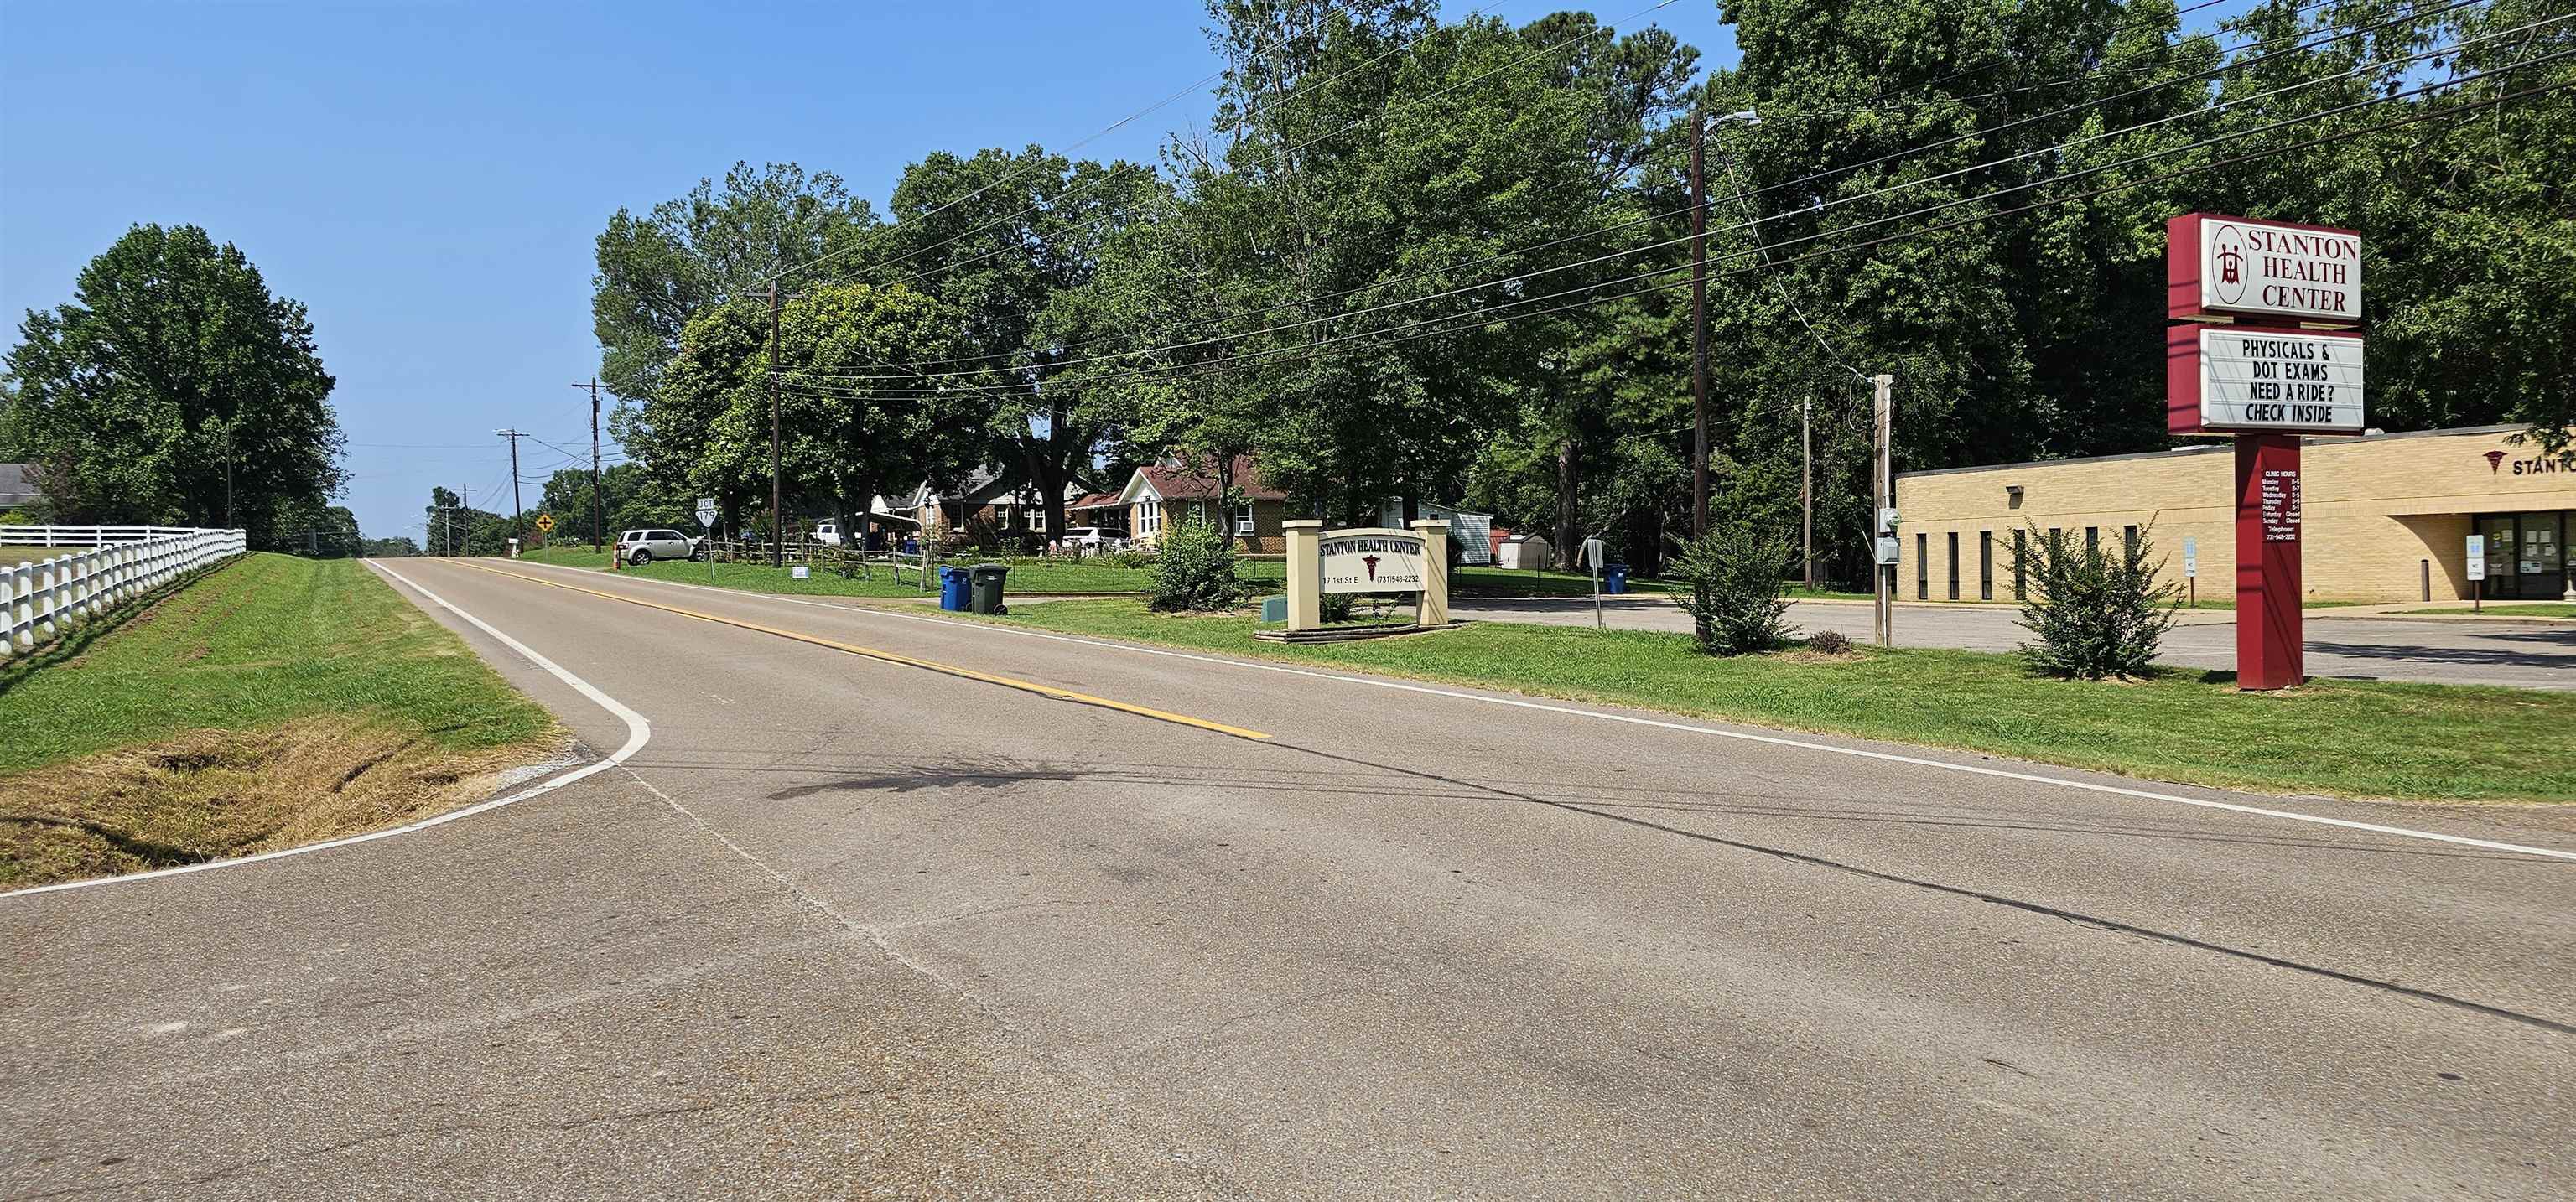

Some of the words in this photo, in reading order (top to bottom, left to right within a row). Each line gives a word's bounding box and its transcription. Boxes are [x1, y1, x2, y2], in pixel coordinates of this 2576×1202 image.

[2248, 230, 2357, 261] STANTON
[2262, 256, 2346, 285] HEALTH
[2262, 285, 2346, 313] CENTER
[2242, 339, 2314, 360] PHYSICALS
[2322, 344, 2329, 360] &
[2253, 361, 2278, 379] DOT
[2285, 364, 2328, 381] EXAMS
[2250, 382, 2281, 401] NEED
[2286, 385, 2293, 401] A
[2246, 403, 2284, 422] CHECK
[2292, 404, 2332, 422] INSIDE
[699, 511, 714, 520] 179
[1320, 540, 1356, 557] STANTON
[1358, 539, 1389, 552] HEALTH
[1390, 540, 1421, 557] CENTER
[1353, 576, 1358, 584] E
